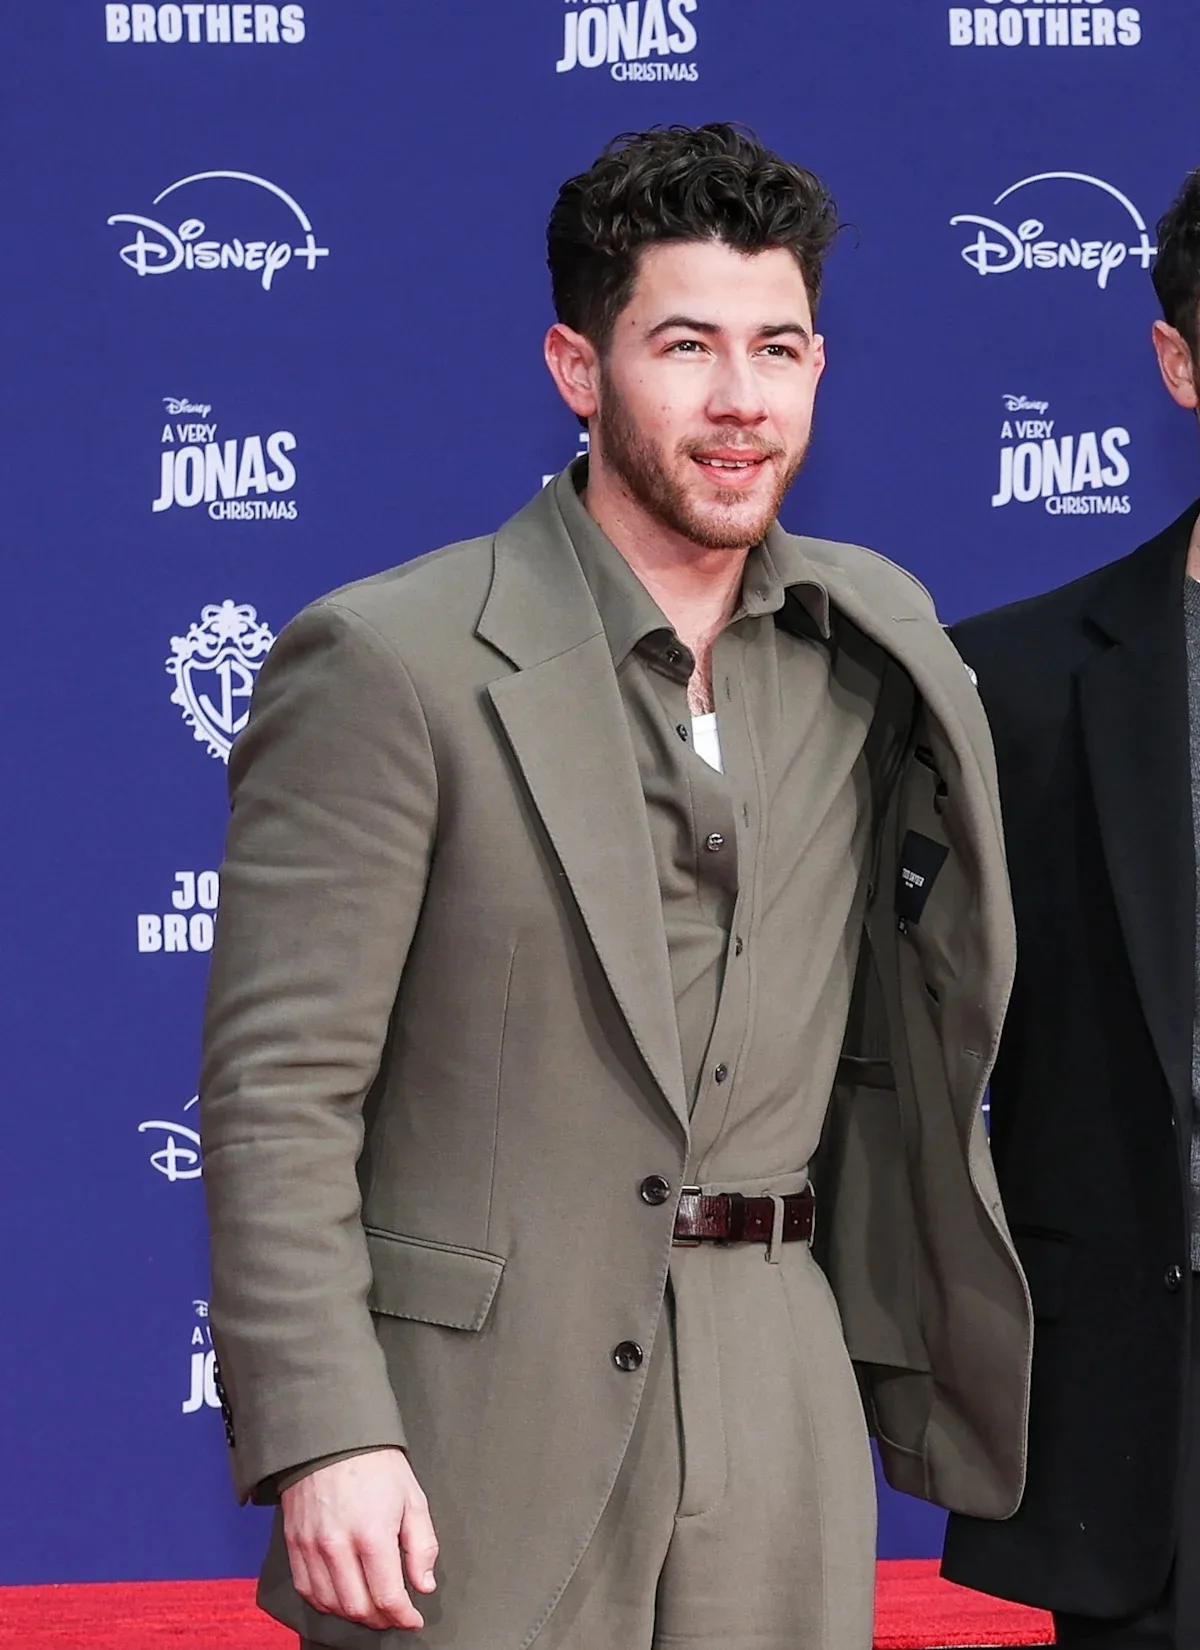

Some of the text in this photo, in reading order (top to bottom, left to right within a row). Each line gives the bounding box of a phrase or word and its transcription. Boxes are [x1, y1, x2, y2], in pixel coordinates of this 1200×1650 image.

[105, 3, 305, 43] BROTHERS
[949, 8, 1141, 46] BROTHERS
[556, 0, 698, 73] JONAS
[611, 62, 699, 82] CHRISTMAS
[107, 214, 330, 291] Disney+
[163, 397, 212, 418] Disney
[1003, 394, 1049, 415] Disney
[161, 423, 217, 443] A VERY
[1001, 420, 1054, 439] A VERY
[152, 431, 297, 512] JONAS
[991, 427, 1130, 507] JONAS
[208, 500, 298, 520] CHRISTMAS
[1045, 495, 1131, 515] CHRISTMAS
